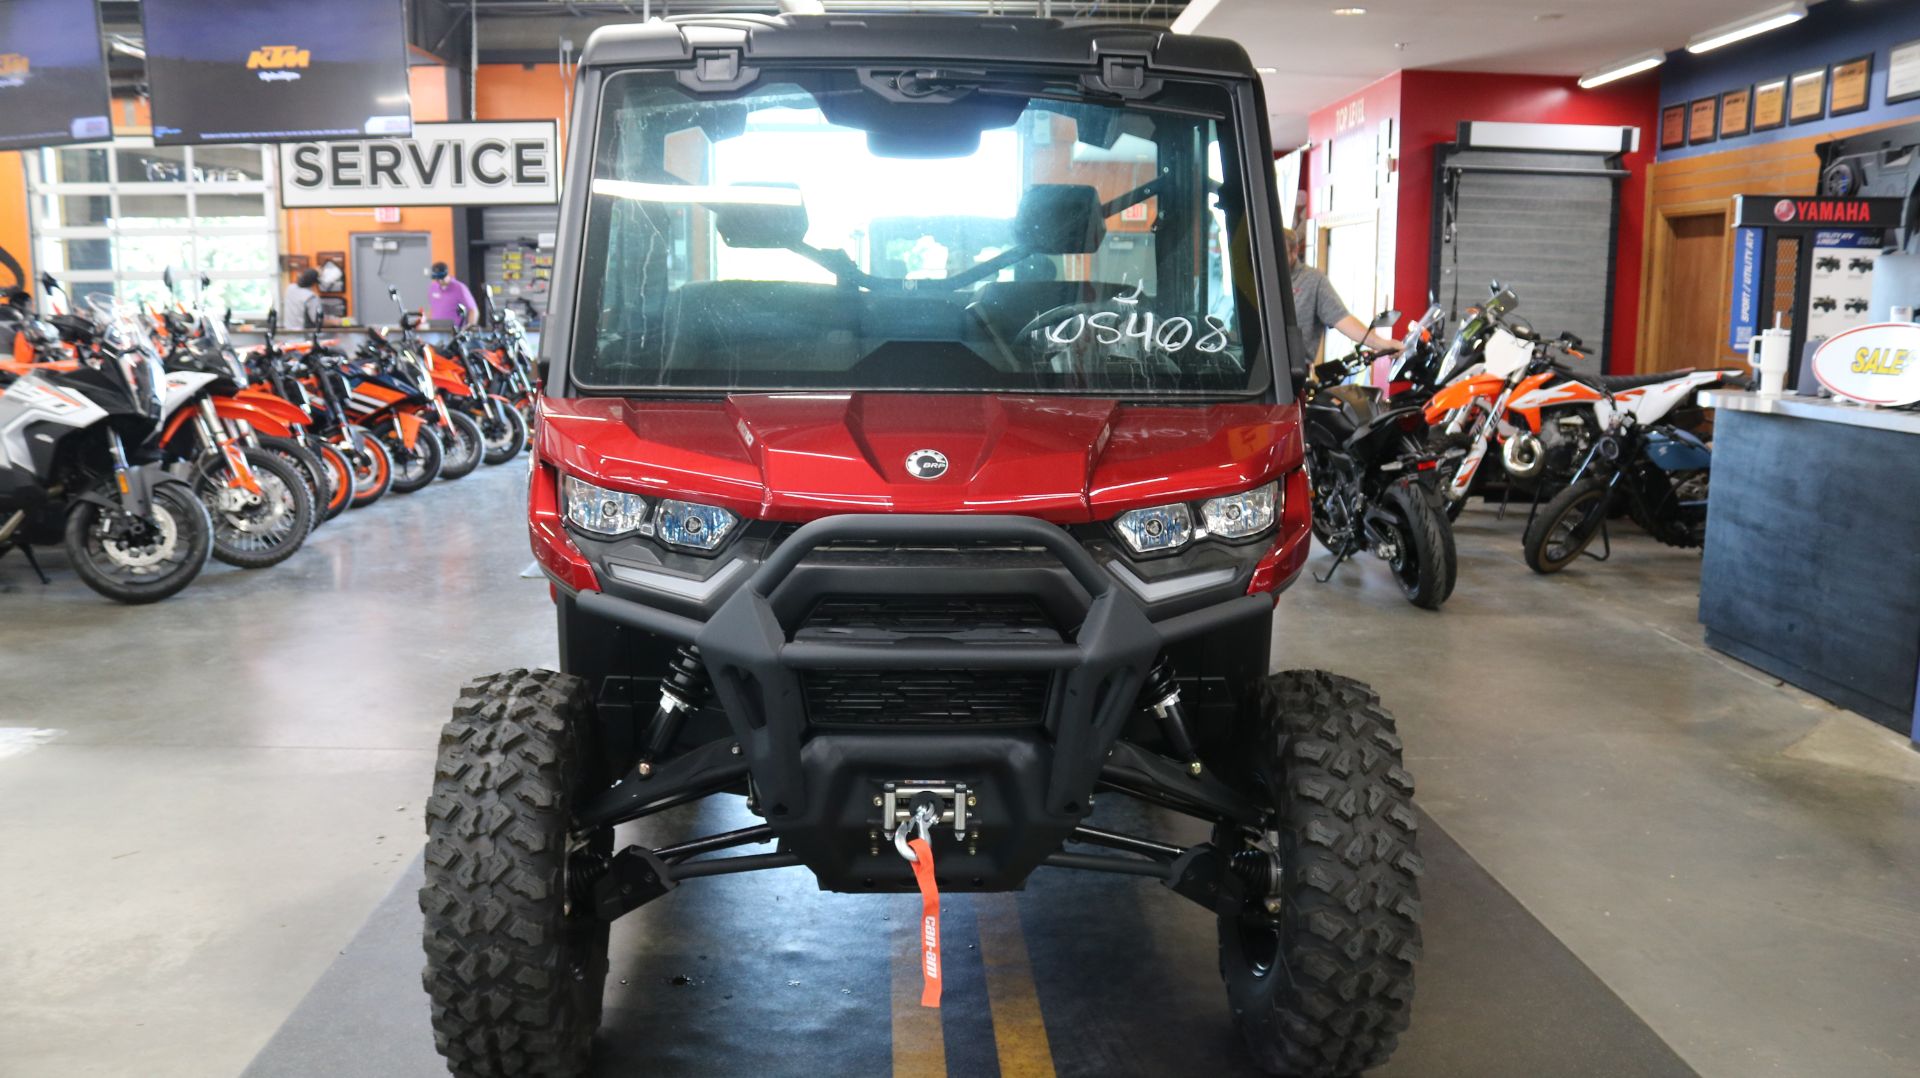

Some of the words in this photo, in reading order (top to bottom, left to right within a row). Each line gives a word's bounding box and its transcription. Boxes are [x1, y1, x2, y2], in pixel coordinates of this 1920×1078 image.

[246, 45, 311, 69] KTM
[292, 140, 548, 188] SERVICE
[1797, 201, 1870, 222] YAMAHA
[1745, 230, 1755, 249] ATV
[1743, 249, 1754, 284] UTILITY
[1741, 291, 1750, 323] SPORT
[925, 916, 937, 978] can-am
